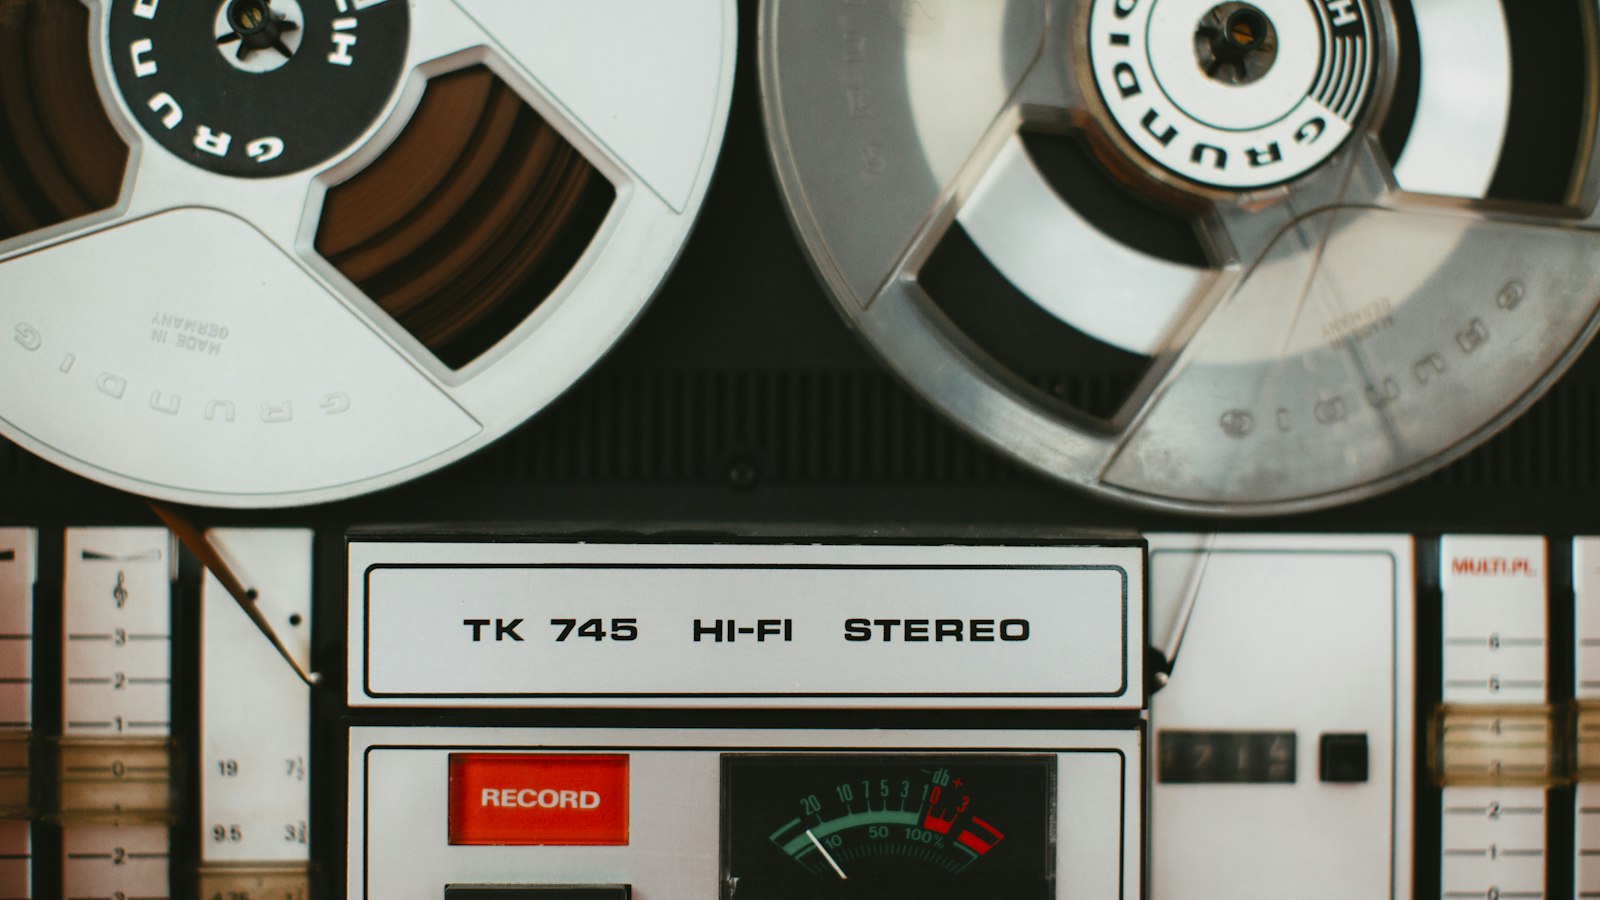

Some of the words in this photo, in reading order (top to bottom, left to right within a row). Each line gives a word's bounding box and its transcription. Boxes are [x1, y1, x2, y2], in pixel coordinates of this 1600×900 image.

[152, 312, 229, 341] GERMANY
[151, 329, 168, 344] IN
[175, 334, 222, 356] MADE
[13, 321, 352, 424] GRUNDIG
[114, 629, 126, 645] 3
[463, 618, 525, 642] TK
[550, 618, 638, 642] 745
[693, 618, 793, 643] HI-FI
[843, 618, 1031, 642] STEREO
[1489, 633, 1501, 650] 6
[114, 673, 126, 690] 2
[115, 717, 122, 732] 1
[112, 761, 124, 778] 0
[217, 759, 239, 777] 19
[481, 788, 601, 809] RECORD
[800, 794, 822, 817] 20
[836, 783, 853, 803] 10
[862, 780, 870, 798] 7
[880, 779, 889, 797] 5
[900, 780, 910, 798] 3
[922, 784, 929, 801] 1
[929, 786, 941, 804] 0
[957, 796, 970, 813] 3
[1488, 802, 1501, 819] 2
[213, 824, 242, 842] 9.5
[824, 834, 843, 850] 10
[868, 826, 889, 839] 50
[905, 828, 945, 849] 100%
[114, 846, 126, 865] 2
